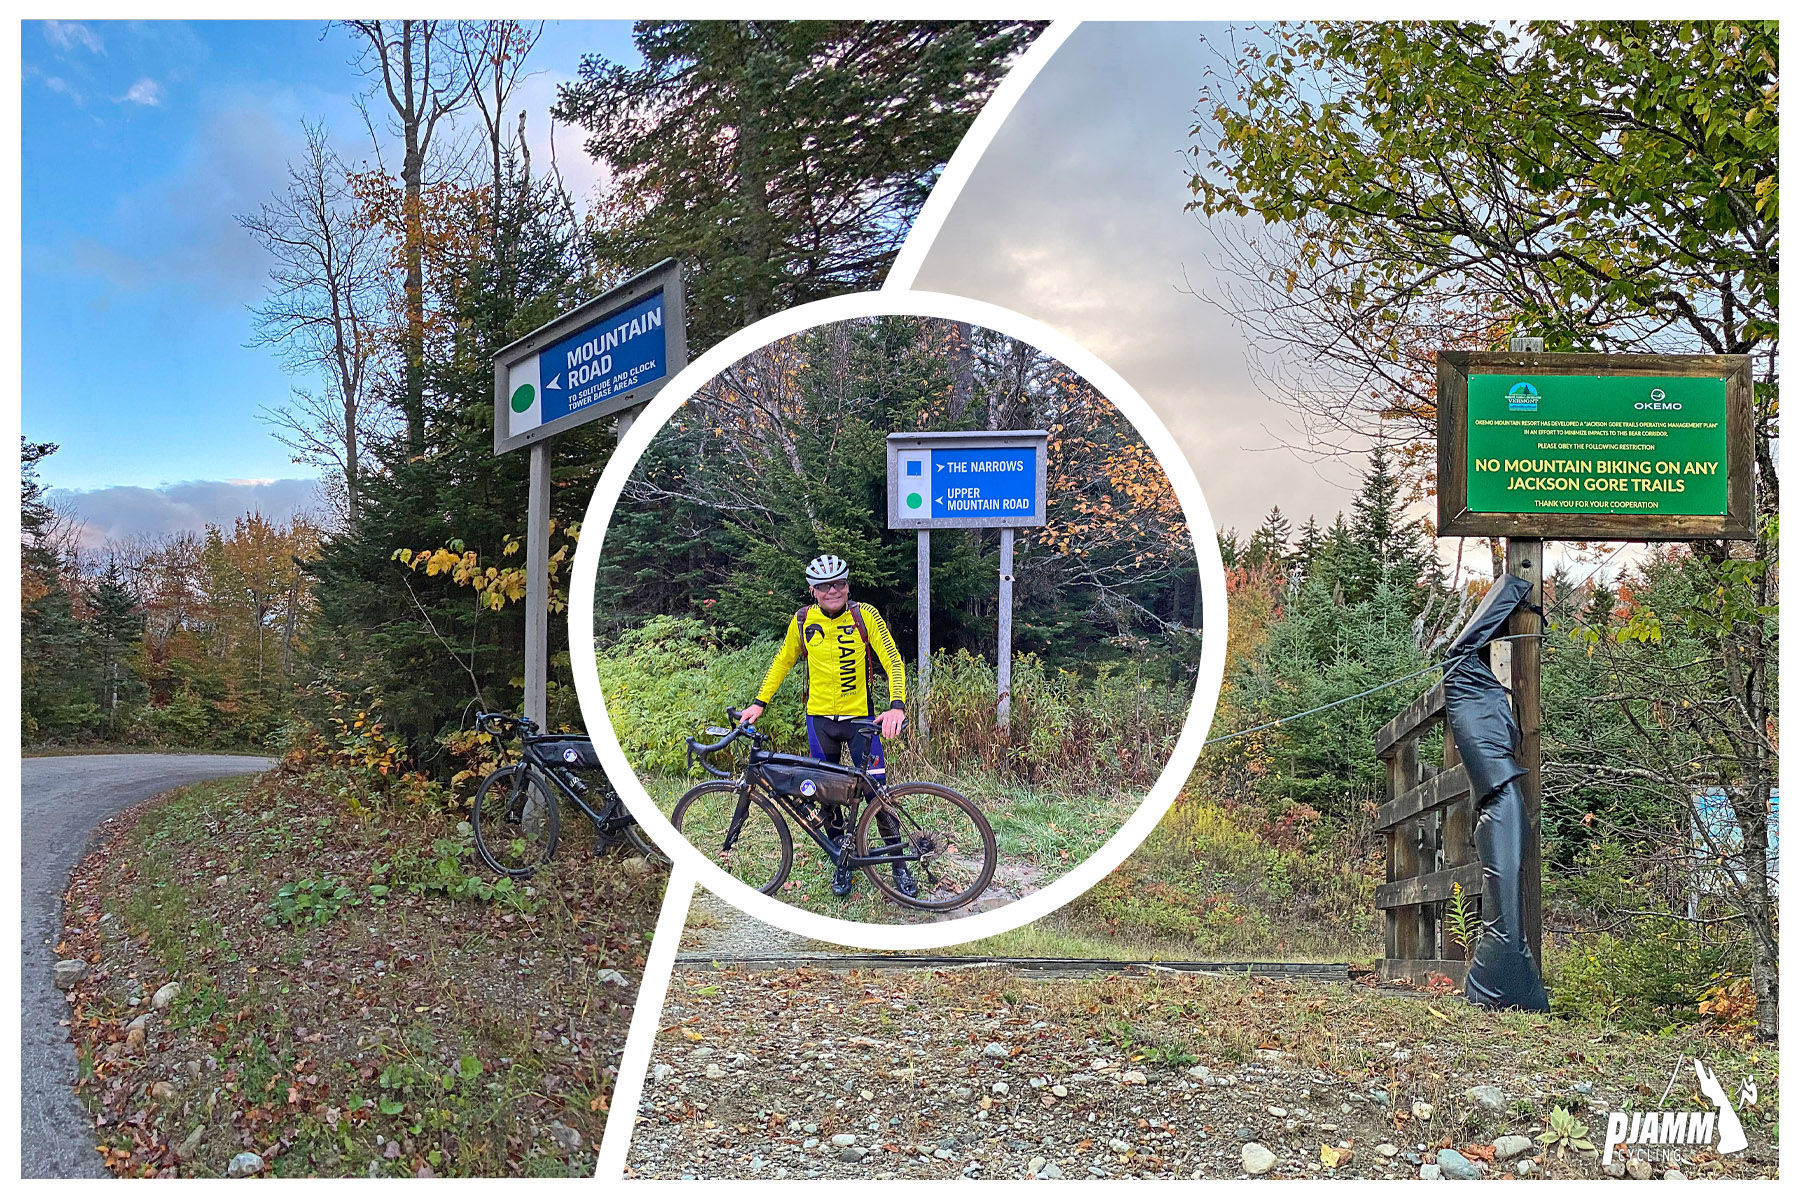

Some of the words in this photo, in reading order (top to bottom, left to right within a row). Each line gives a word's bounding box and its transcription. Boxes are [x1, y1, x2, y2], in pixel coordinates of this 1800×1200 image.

[566, 307, 661, 370] MOUNTAIN
[568, 354, 612, 390] ROAD
[568, 394, 577, 403] TO
[578, 379, 610, 399] SOLITUDE
[612, 371, 628, 384] AND
[629, 360, 656, 376] CLOCK
[568, 397, 592, 411] TOWER
[593, 388, 611, 400] BASE
[613, 376, 638, 392] AREAS
[1634, 402, 1682, 410] OKEMO
[947, 462, 968, 473] THE
[970, 460, 1024, 472] NARROWS
[1475, 458, 1500, 472] NO
[1504, 459, 1592, 473] MOUNTAIN
[1596, 460, 1651, 474] BIKING
[1655, 461, 1680, 474] ON
[1683, 461, 1719, 475] ANY
[1507, 477, 1580, 491] JACKSON
[1583, 478, 1628, 491] GORE
[1630, 479, 1685, 492] TRAILS
[947, 487, 980, 499] UPPER
[947, 499, 1000, 511] MOUNTAIN
[1002, 498, 1029, 510] ROAD
[1575, 500, 1589, 508] FOR
[1590, 500, 1609, 508] YOUR
[837, 625, 856, 692] PJAMM
